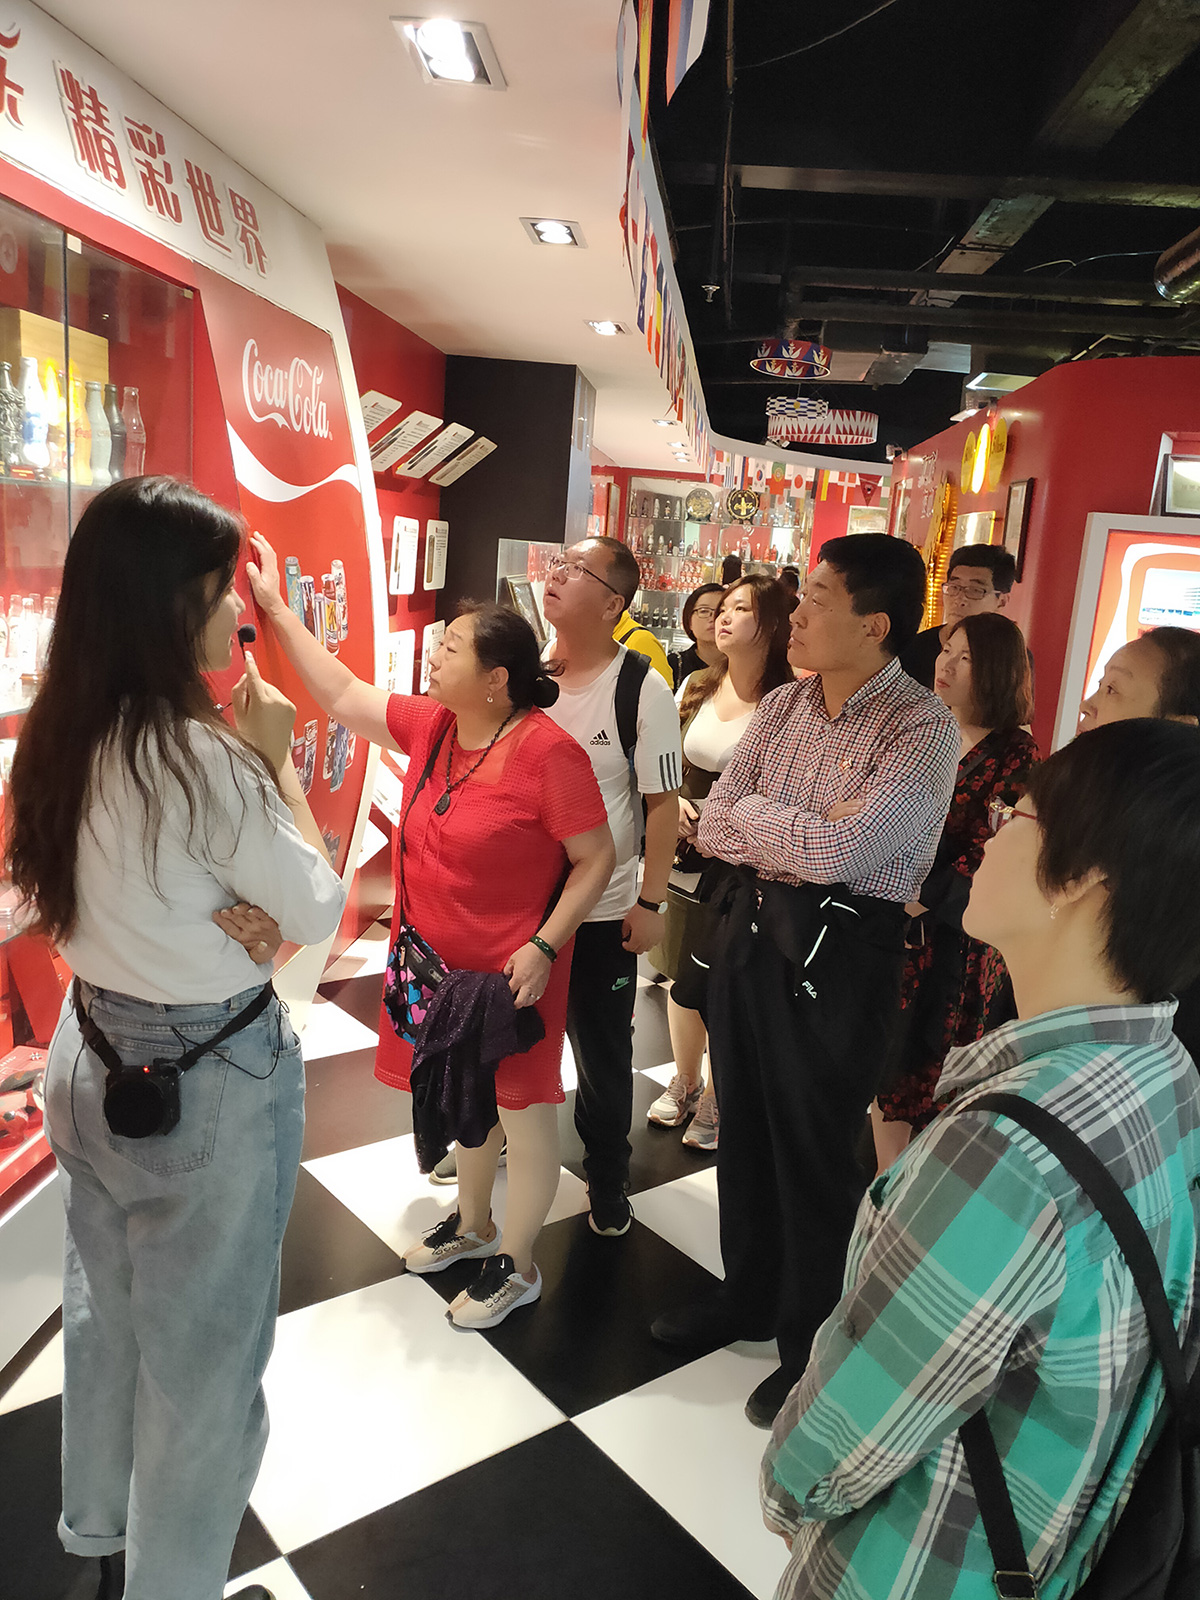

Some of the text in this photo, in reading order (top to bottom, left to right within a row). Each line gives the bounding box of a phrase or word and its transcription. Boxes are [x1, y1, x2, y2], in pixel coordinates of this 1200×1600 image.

[57, 66, 269, 276] 精彩世界
[589, 738, 611, 746] adidas
[802, 980, 818, 999] FILA
